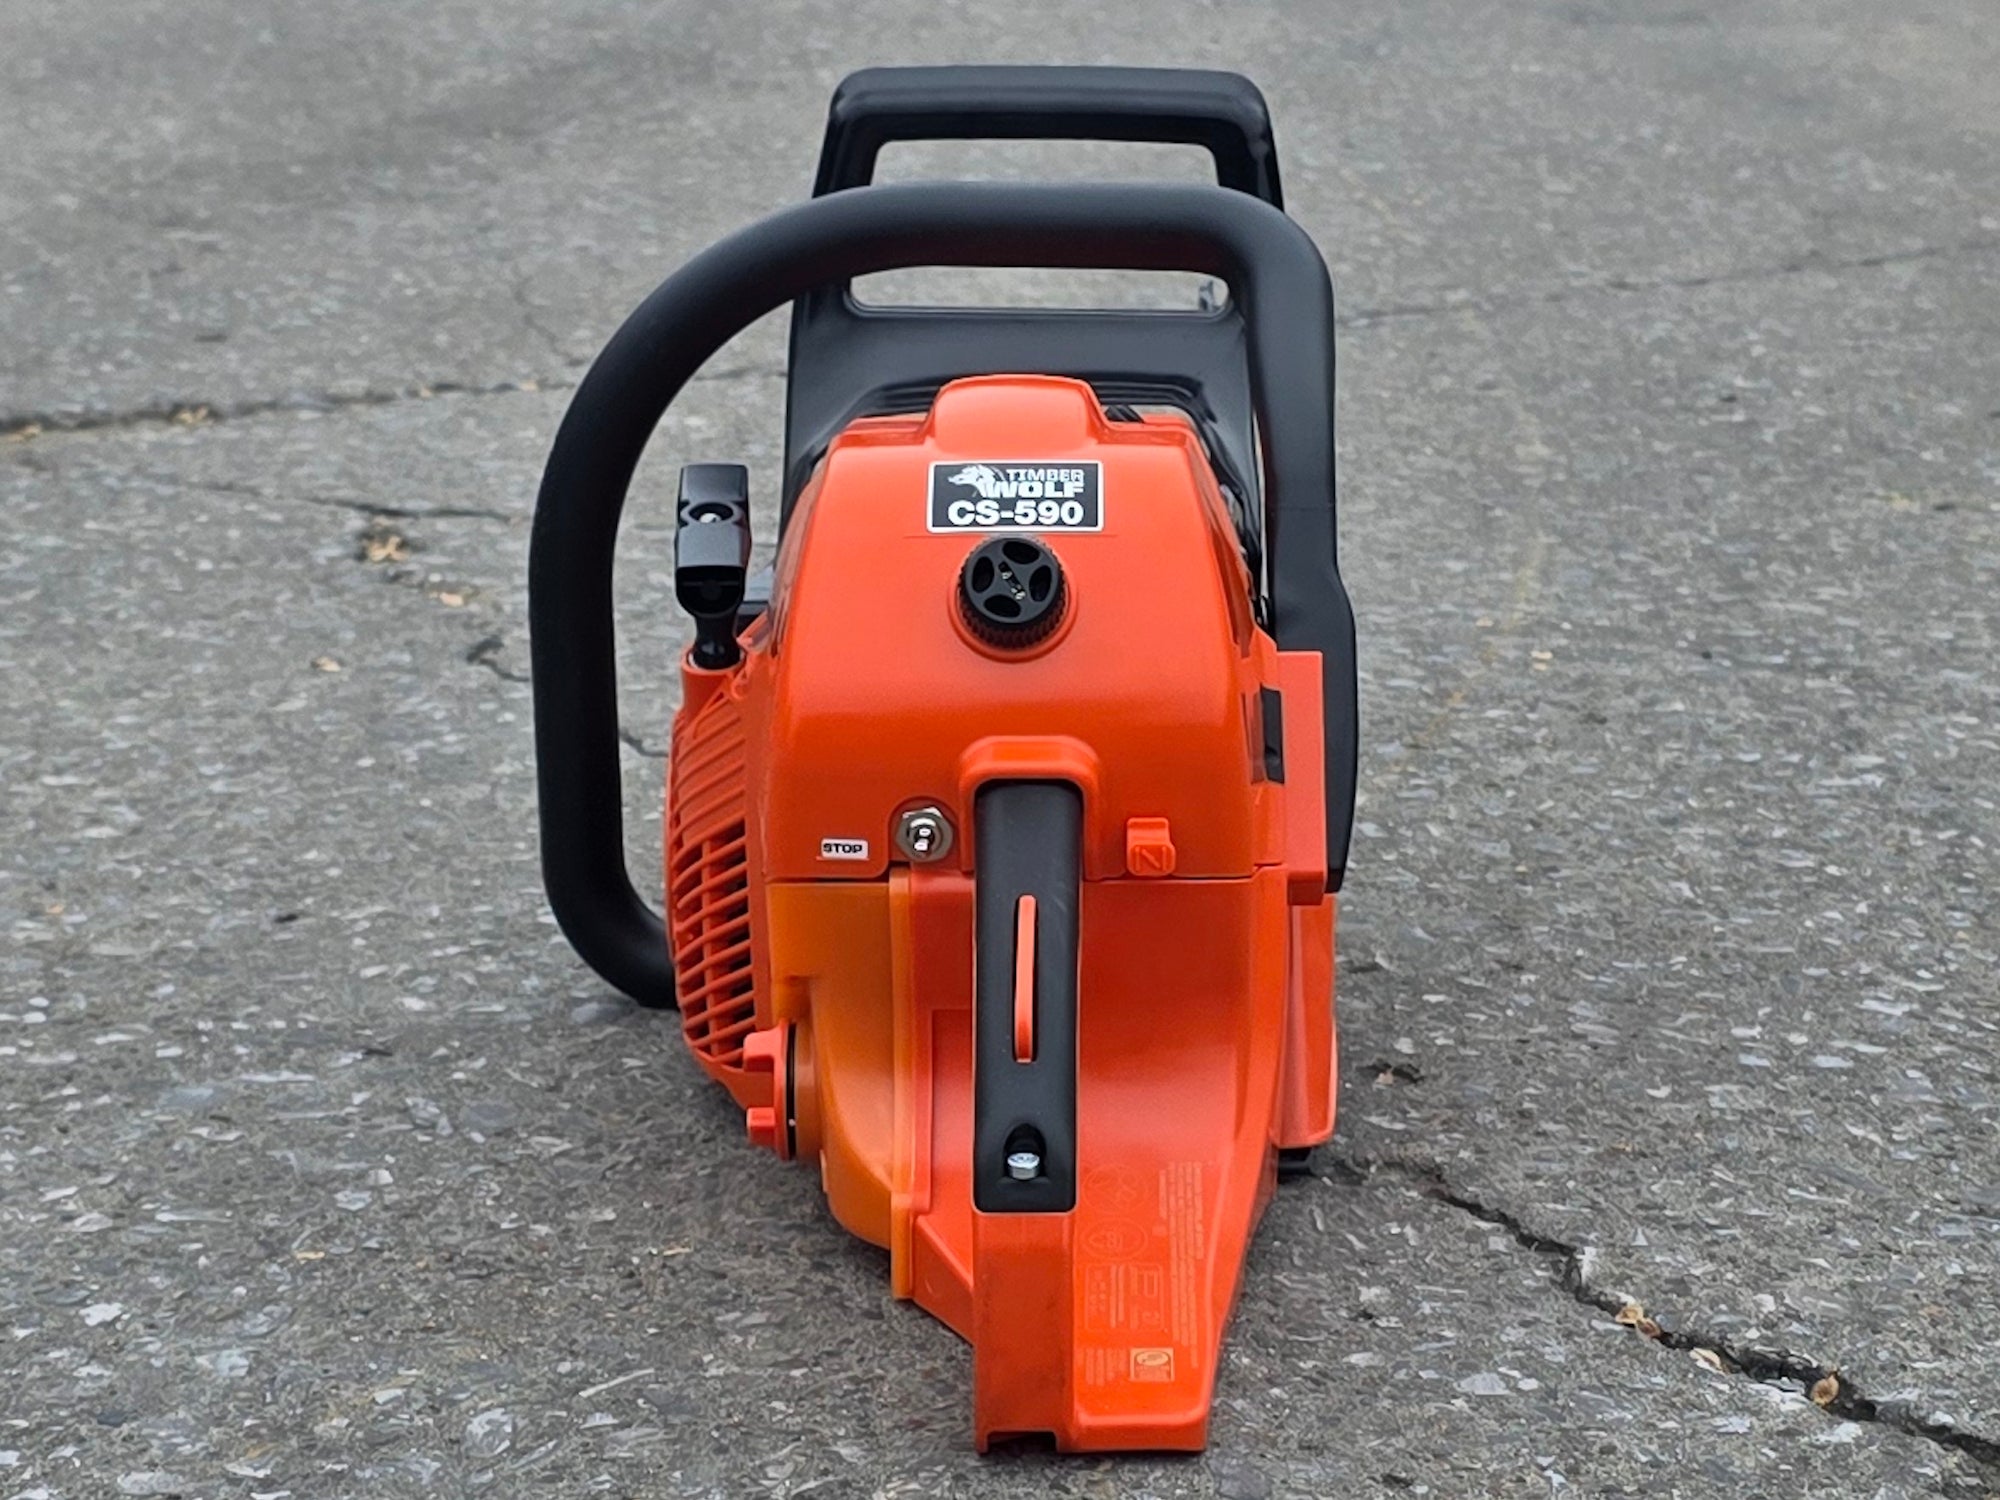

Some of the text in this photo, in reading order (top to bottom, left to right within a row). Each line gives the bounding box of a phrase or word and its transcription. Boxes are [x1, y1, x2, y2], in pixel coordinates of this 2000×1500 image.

[1006, 468, 1084, 483] TIMBER
[988, 481, 1084, 498] WOLF
[947, 499, 1084, 525] CS-590
[823, 843, 863, 853] STOP
